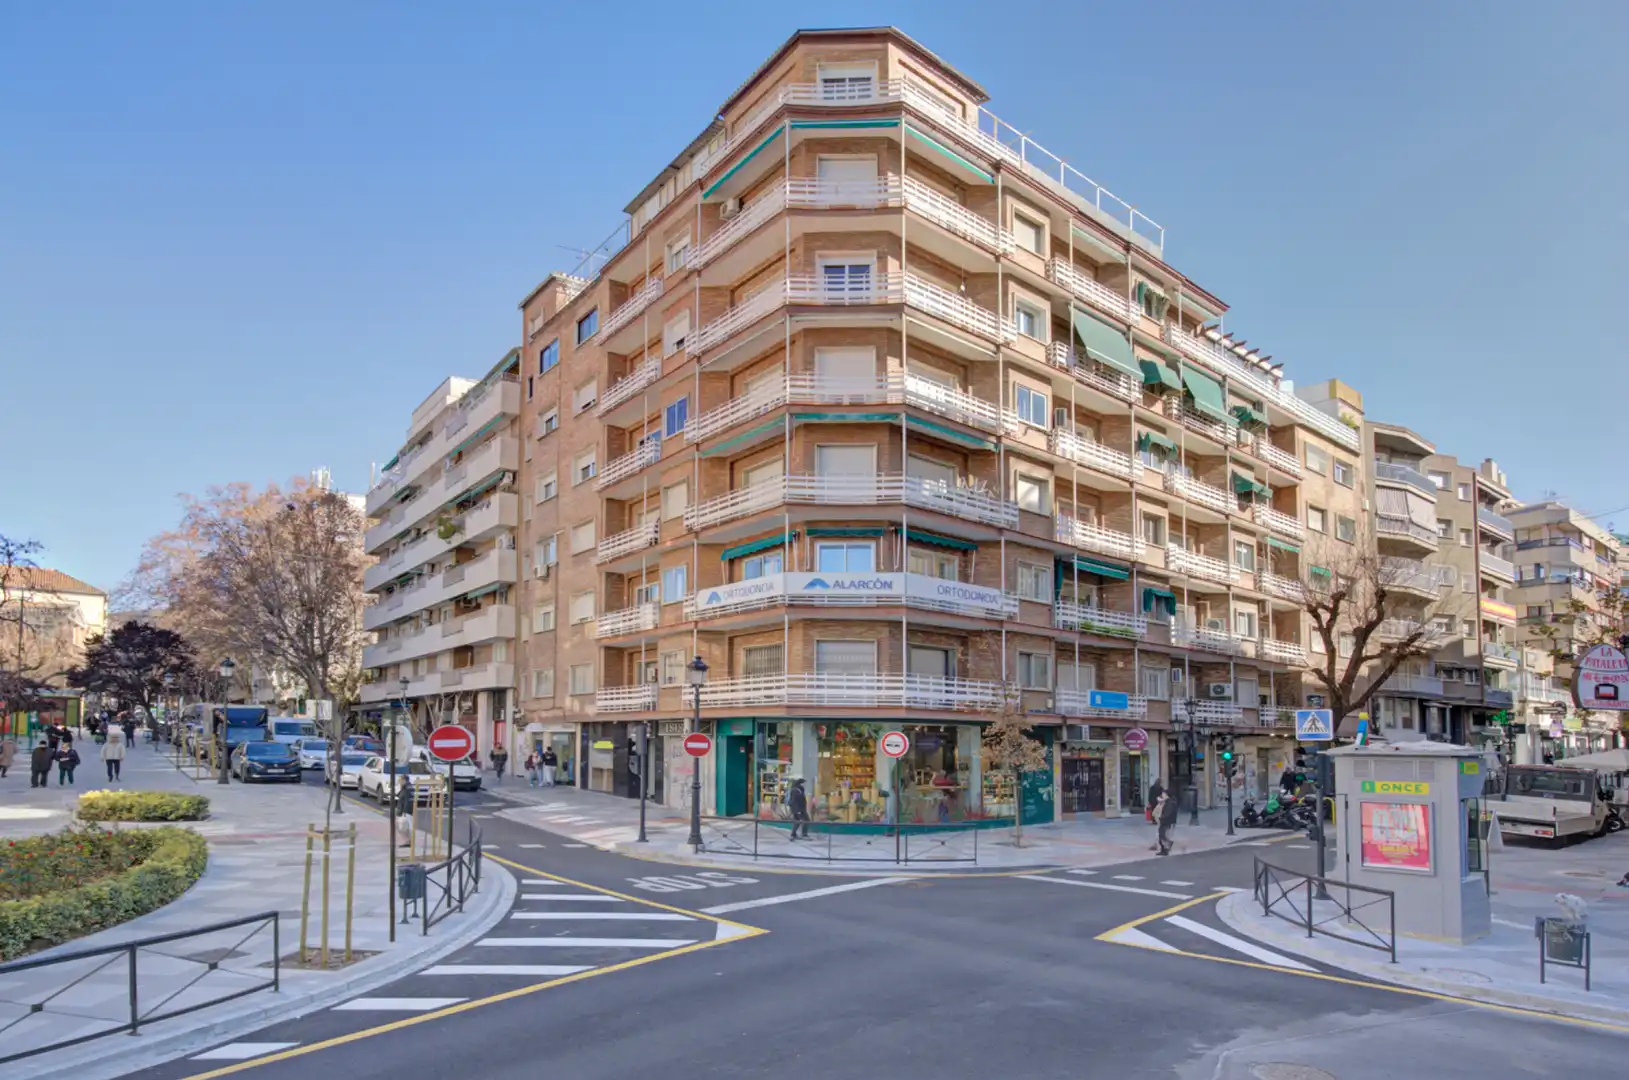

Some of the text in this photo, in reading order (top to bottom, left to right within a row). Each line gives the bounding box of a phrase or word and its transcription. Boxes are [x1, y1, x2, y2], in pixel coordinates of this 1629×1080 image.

[832, 576, 893, 590] ALARCÓN
[937, 584, 998, 605] ORTODONCIA
[1601, 647, 1613, 657] LA
[1381, 783, 1423, 793] ONCE
[624, 872, 760, 893] STOP
